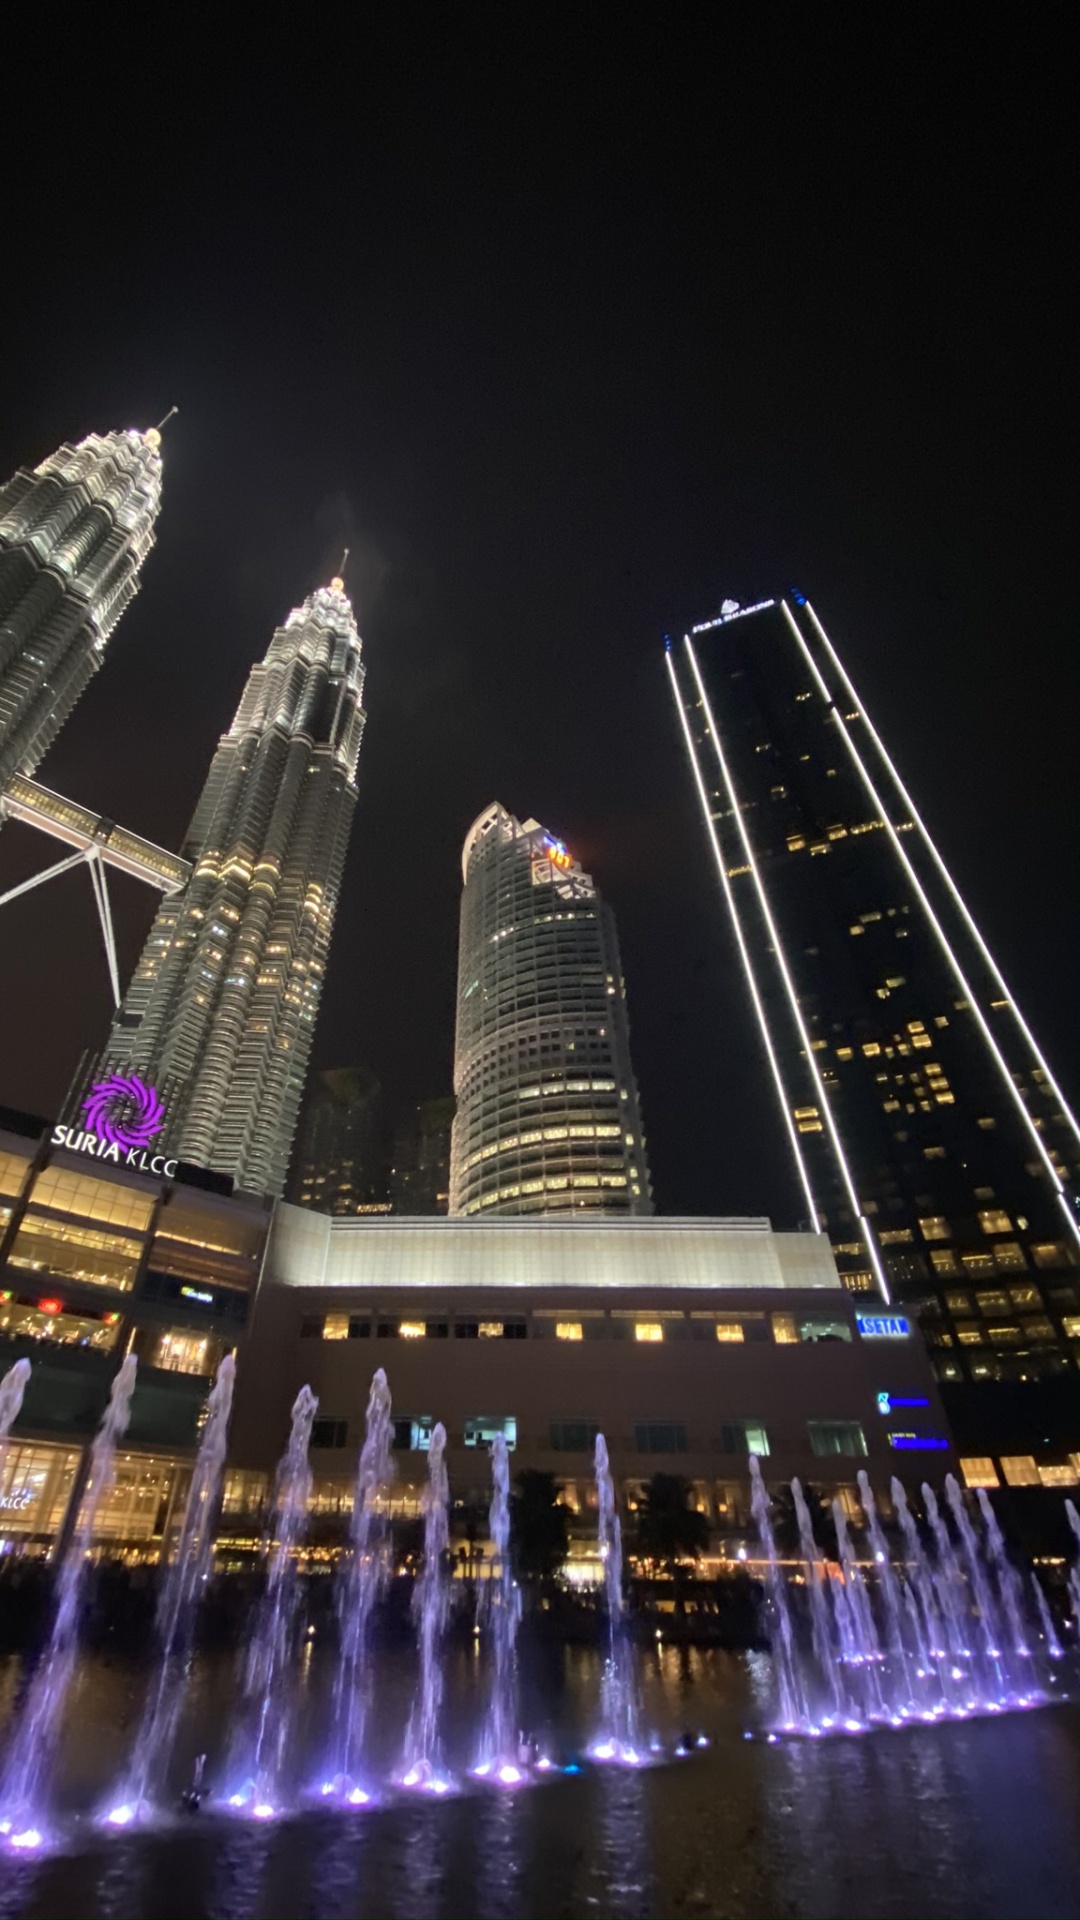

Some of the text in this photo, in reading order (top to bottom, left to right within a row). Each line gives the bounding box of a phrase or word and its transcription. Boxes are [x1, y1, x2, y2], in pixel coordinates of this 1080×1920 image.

[50, 1124, 179, 1178] SURIA KLCC
[856, 1313, 910, 1335] ISETAN
